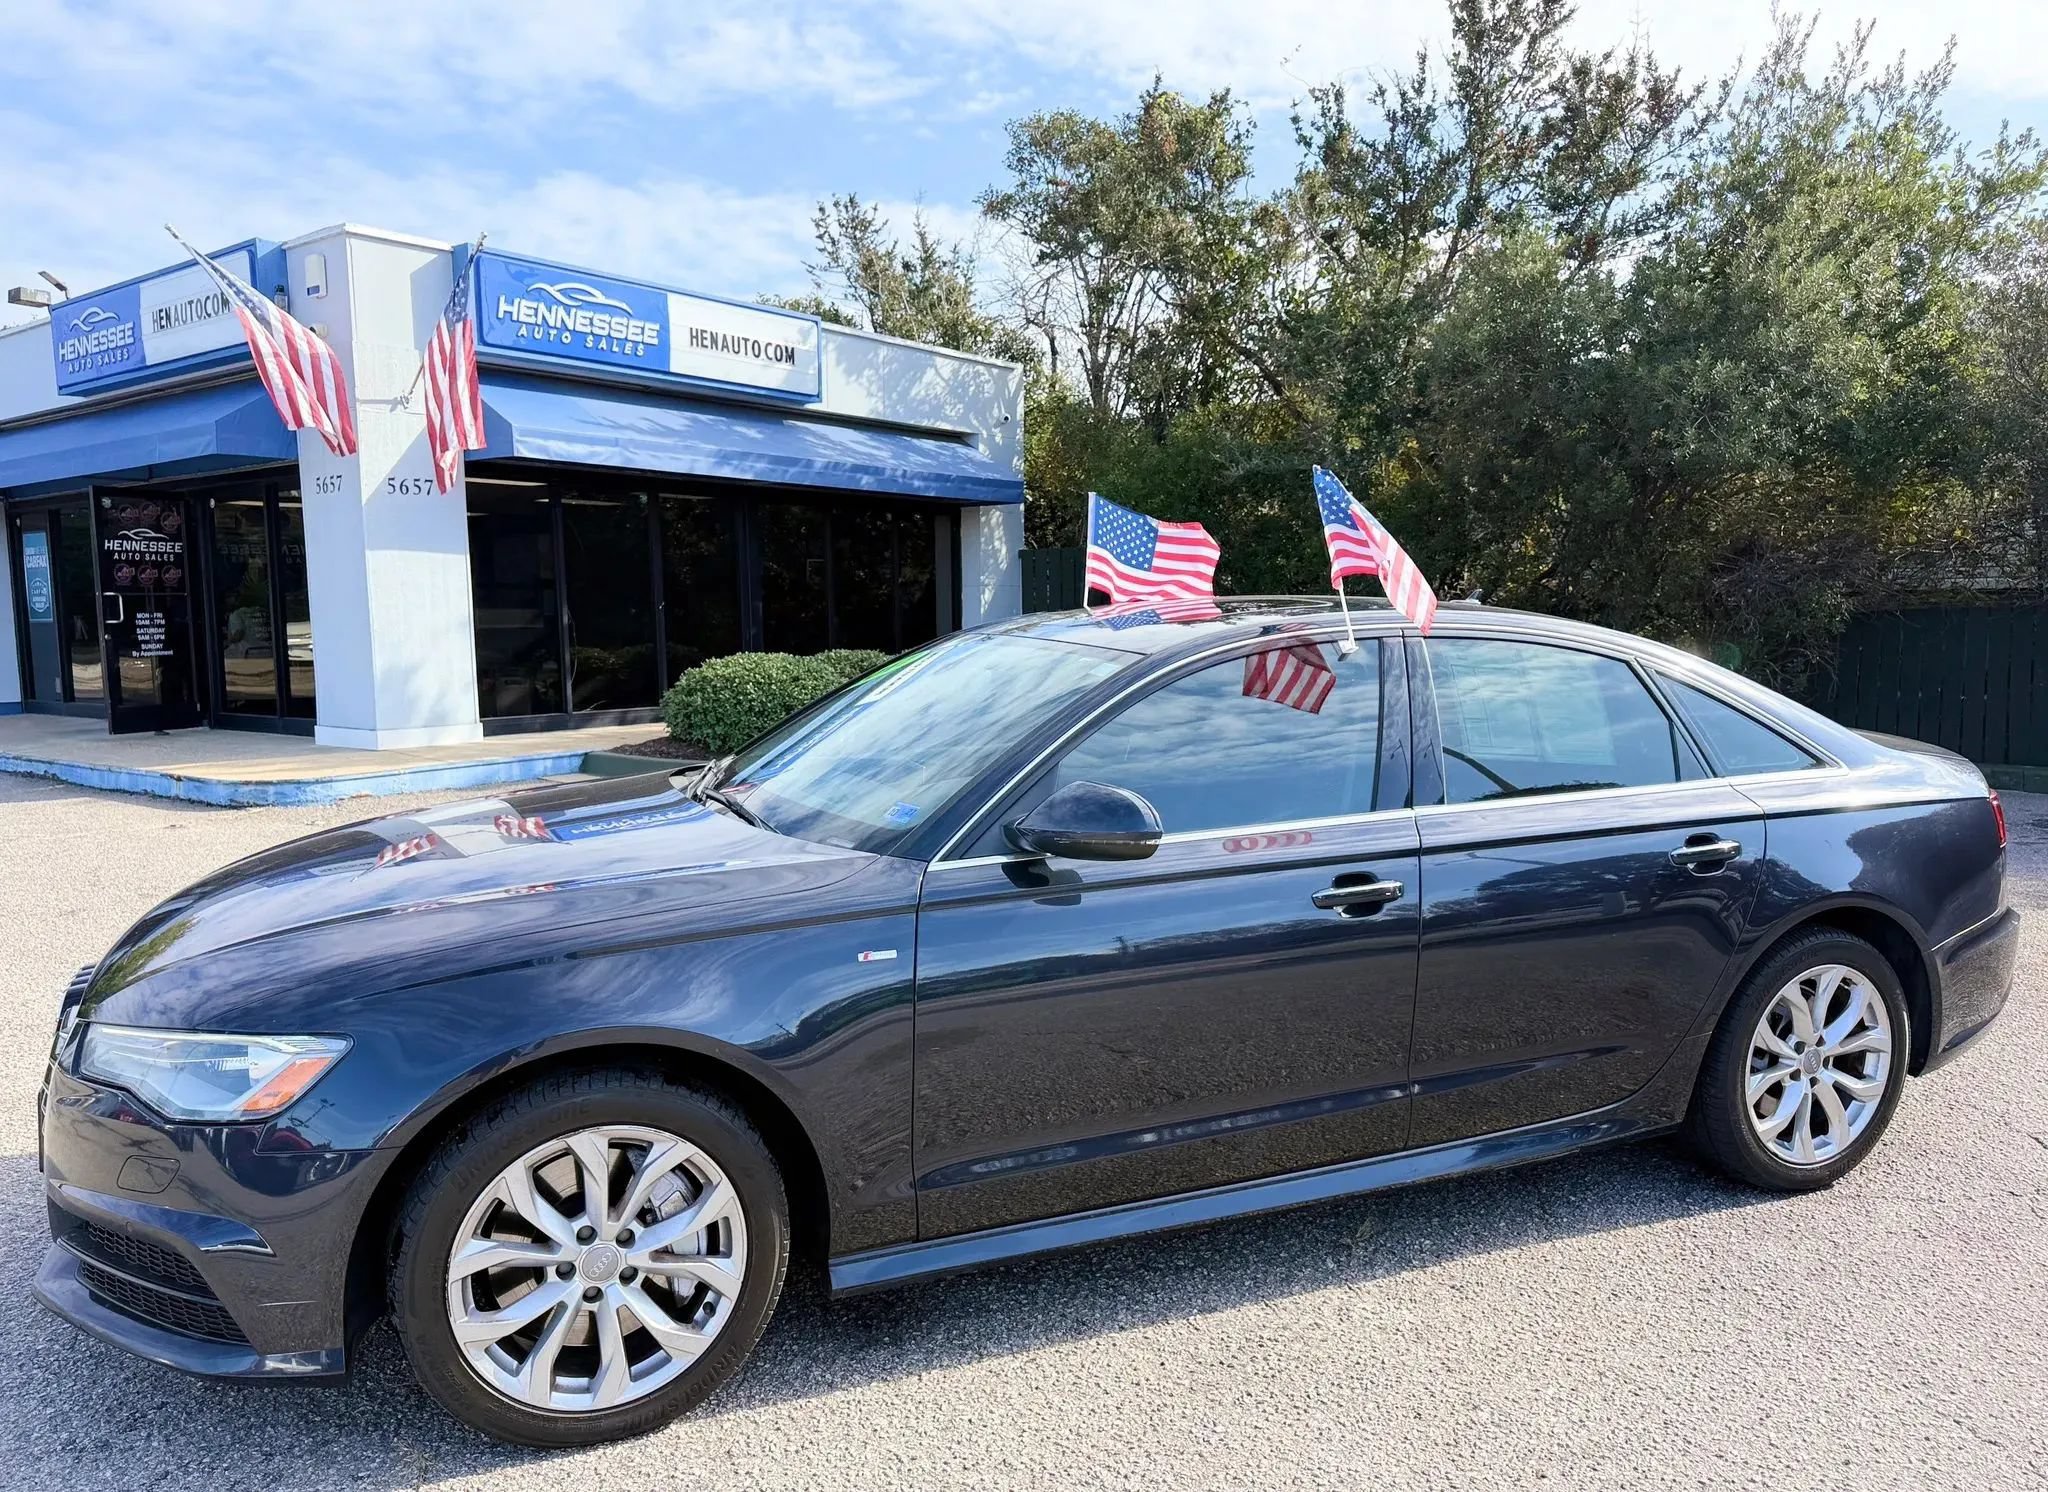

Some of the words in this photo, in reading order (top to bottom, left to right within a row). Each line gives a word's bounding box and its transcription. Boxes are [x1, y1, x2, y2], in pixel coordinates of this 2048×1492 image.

[152, 291, 231, 333] HENAUTO.COM
[497, 294, 660, 346] HENNESSEE
[58, 320, 135, 363] HENNESSEE
[516, 323, 572, 344] AUTO
[586, 335, 645, 357] SALES
[689, 326, 796, 366] HENAUTO.COM
[68, 358, 93, 375] AUTO
[98, 348, 129, 367] SALES
[315, 474, 343, 495] 5657
[386, 477, 434, 497] 5657
[104, 539, 183, 553] HENNESSEE
[113, 552, 141, 561] AUTO
[145, 553, 175, 561] SALES
[132, 650, 140, 658] By
